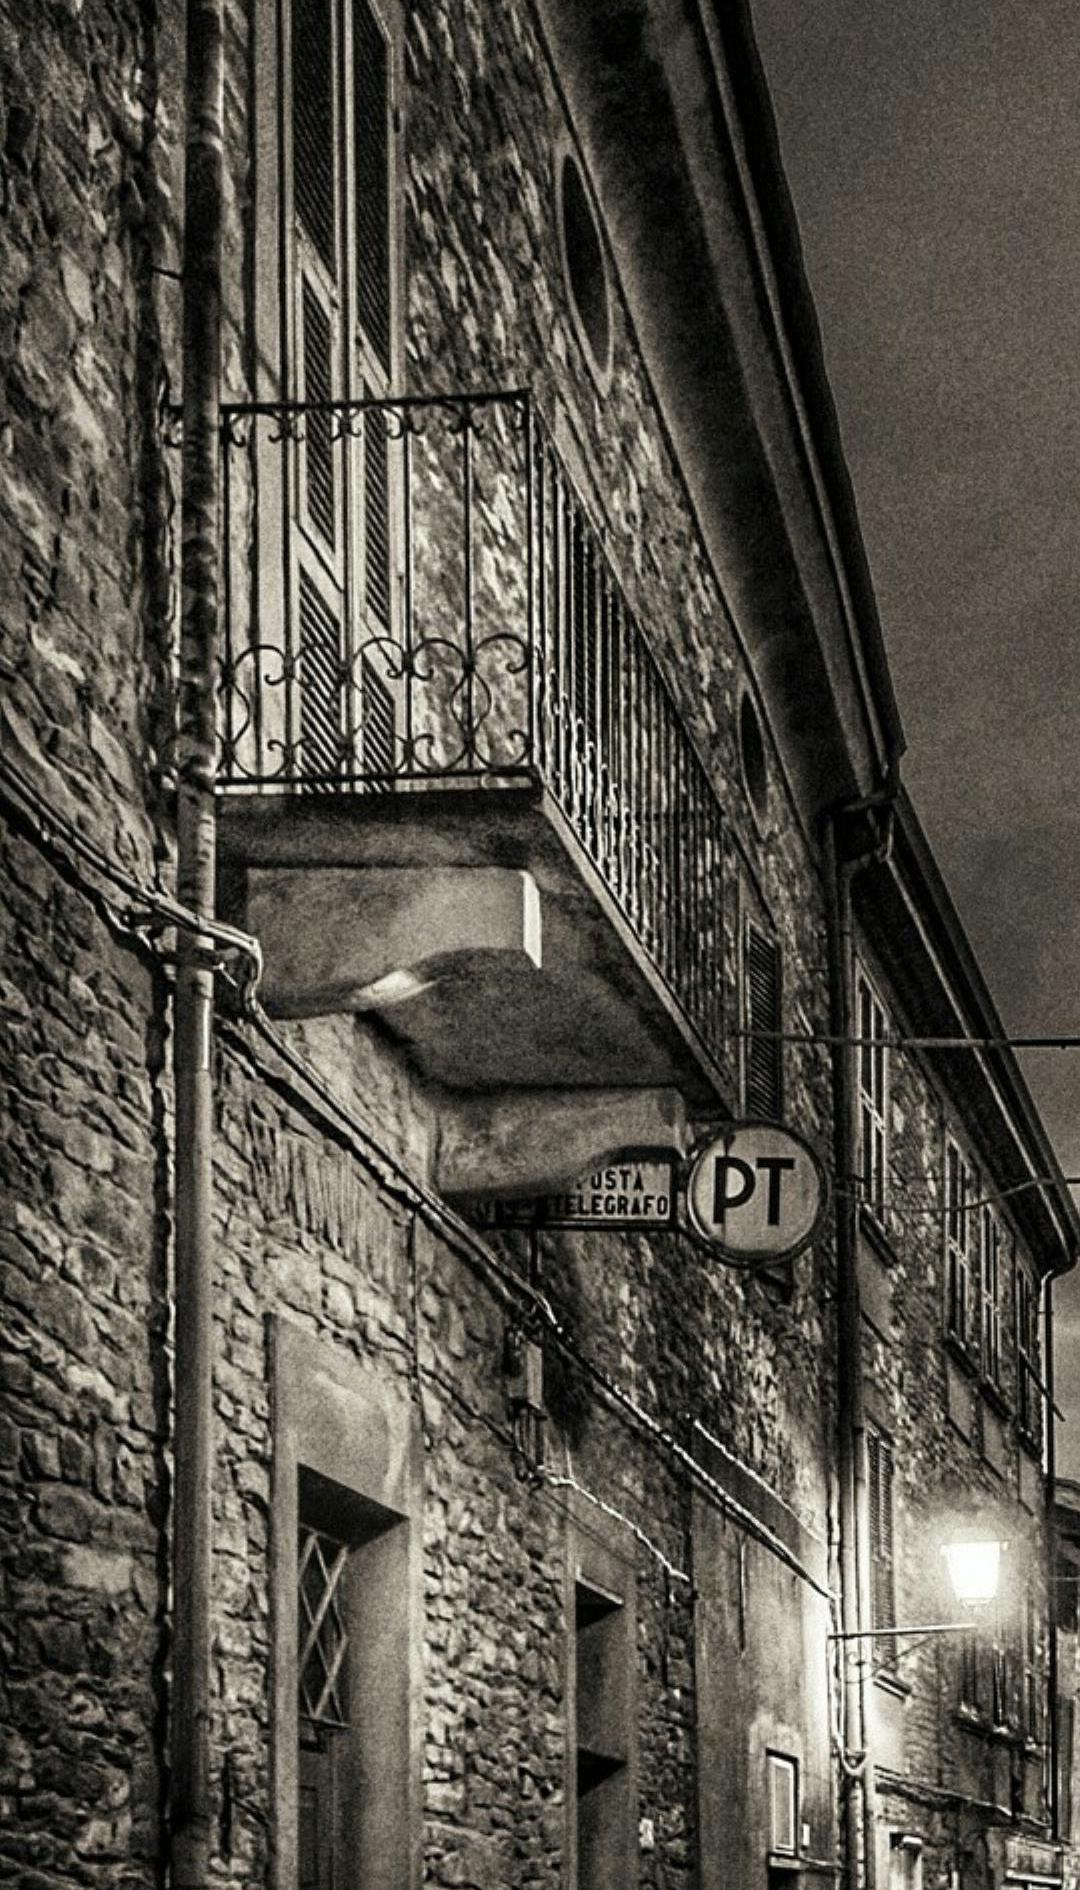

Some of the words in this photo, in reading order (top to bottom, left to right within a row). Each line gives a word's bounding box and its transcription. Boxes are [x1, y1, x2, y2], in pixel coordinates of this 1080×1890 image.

[576, 1168, 645, 1192] OSTA
[712, 1156, 795, 1227] PT
[549, 1193, 669, 1217] TELEGRAFO
